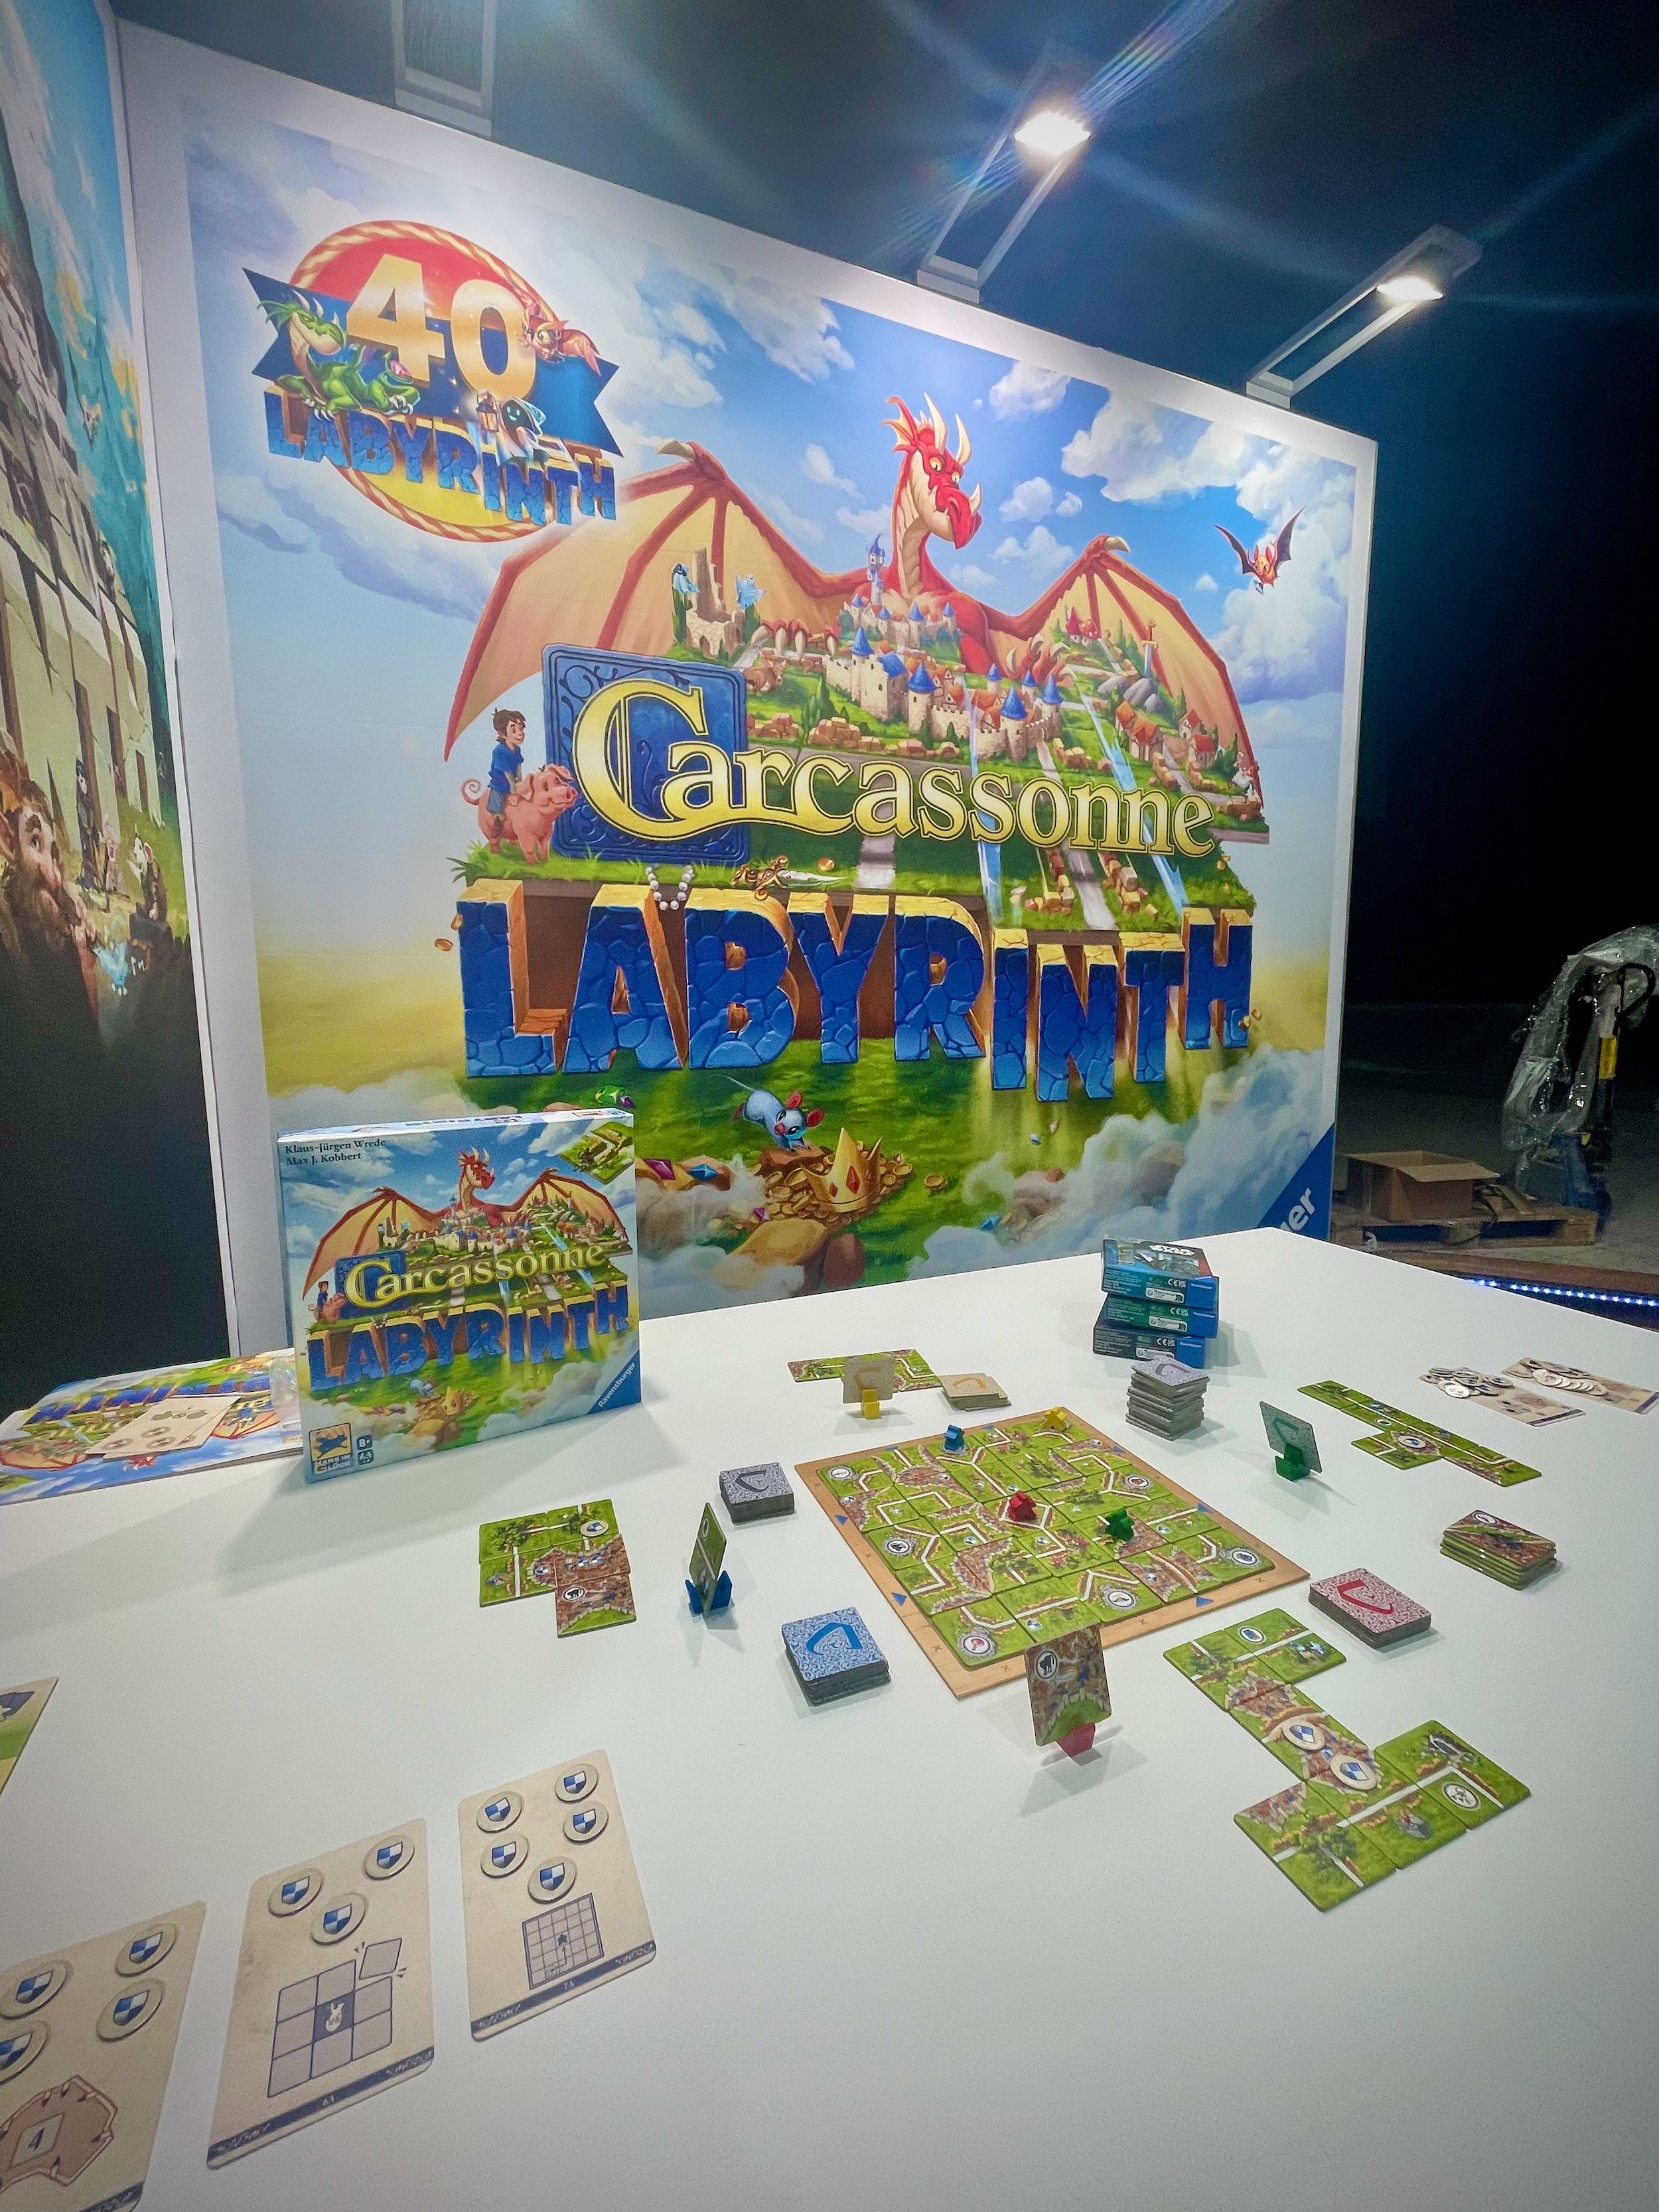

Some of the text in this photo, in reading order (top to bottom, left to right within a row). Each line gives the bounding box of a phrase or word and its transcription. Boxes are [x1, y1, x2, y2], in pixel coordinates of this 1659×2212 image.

[346, 253, 536, 398] 40
[263, 381, 616, 526] LABYRINTH
[572, 677, 1216, 857] Carcassonne
[455, 879, 1253, 1102] LABYRINTH
[285, 1139, 386, 1154] Klaus-Jürgen Wrede
[286, 1156, 309, 1166] Max
[321, 1152, 362, 1163] Kobbert
[344, 1245, 607, 1309] Carcassonne
[307, 1279, 630, 1392] LABYRINTH
[597, 1362, 636, 1408] Ravensburger
[359, 1438, 370, 1447] 8+
[28, 2127, 45, 2150] 4
